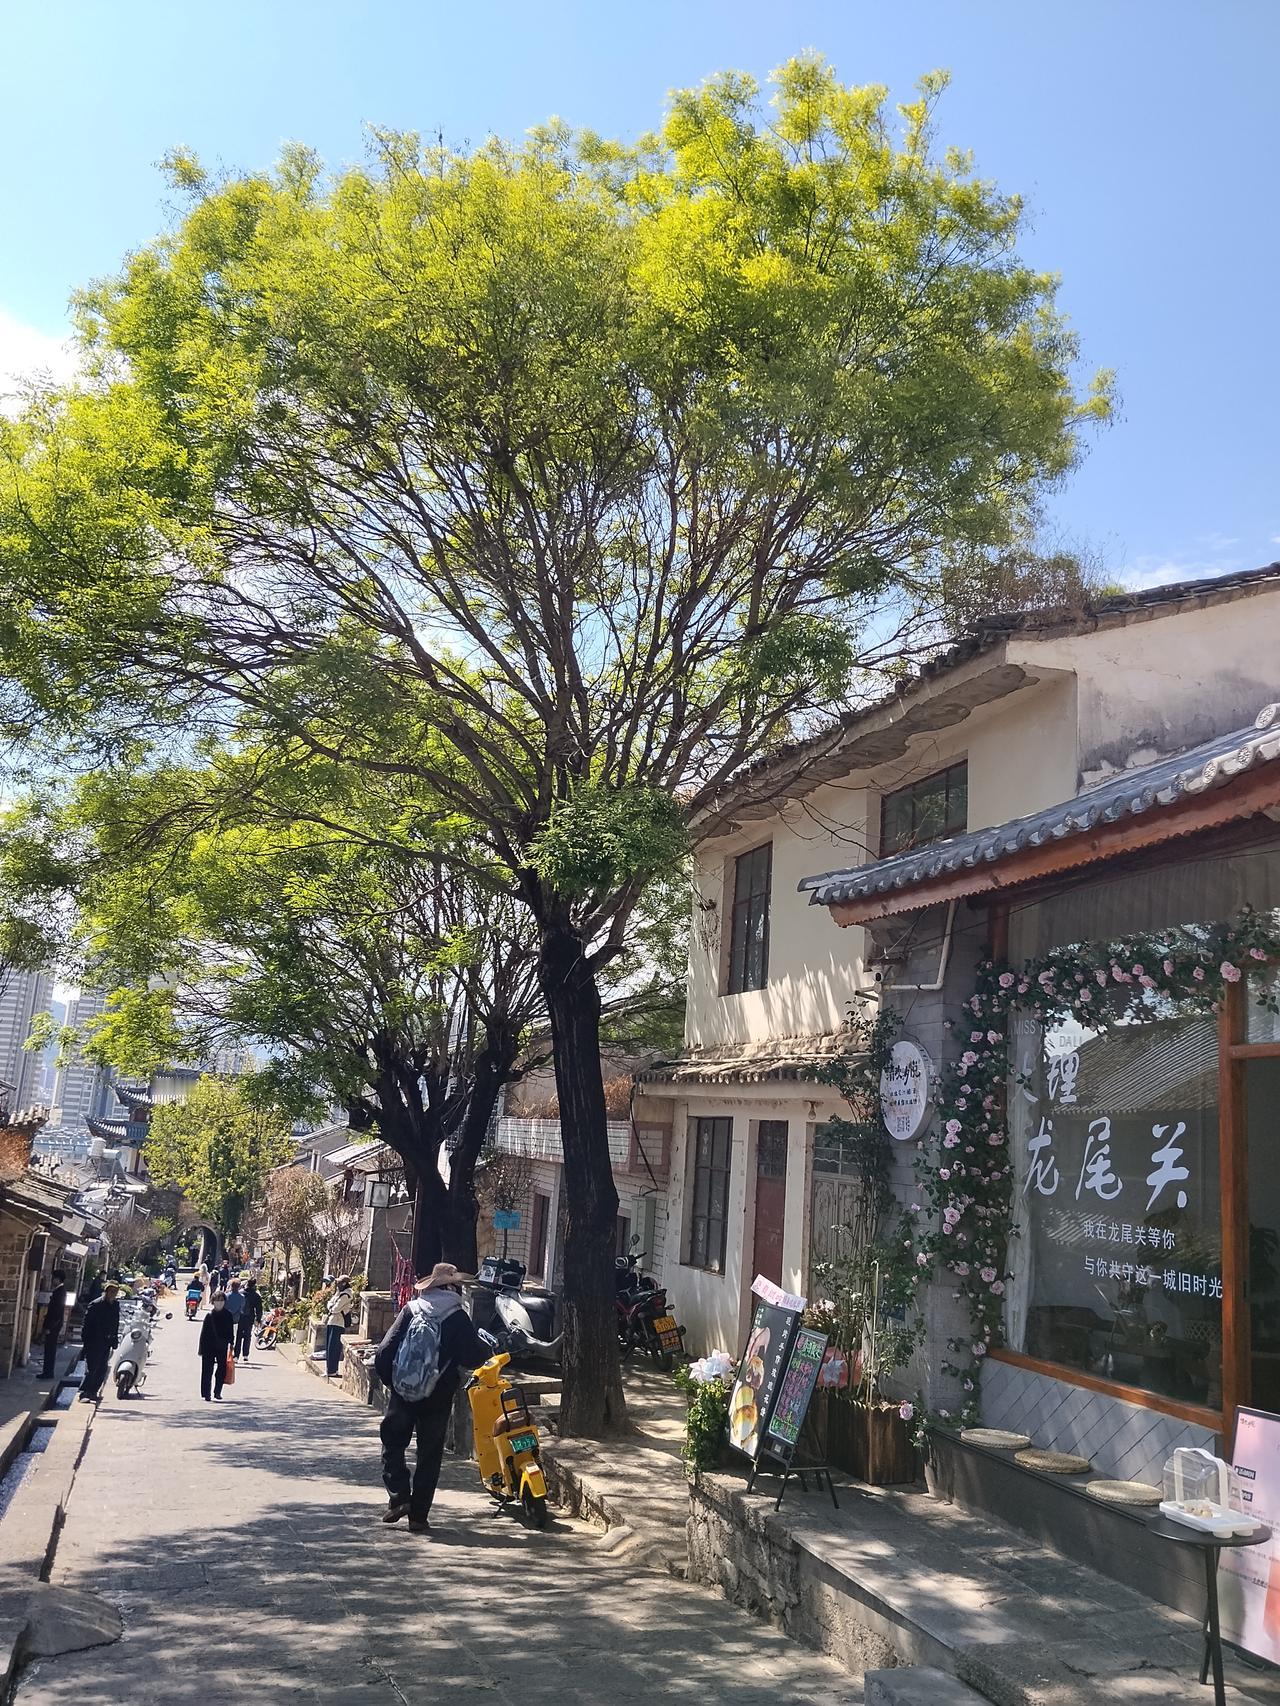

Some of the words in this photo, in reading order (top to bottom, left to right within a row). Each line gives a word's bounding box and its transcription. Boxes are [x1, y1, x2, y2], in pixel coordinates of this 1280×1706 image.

[1022, 1116, 1190, 1211] 龙尾关
[1083, 1220, 1176, 1250] 我在龙尾关等你
[1084, 1255, 1223, 1299] 与你共守这一城旧时光
